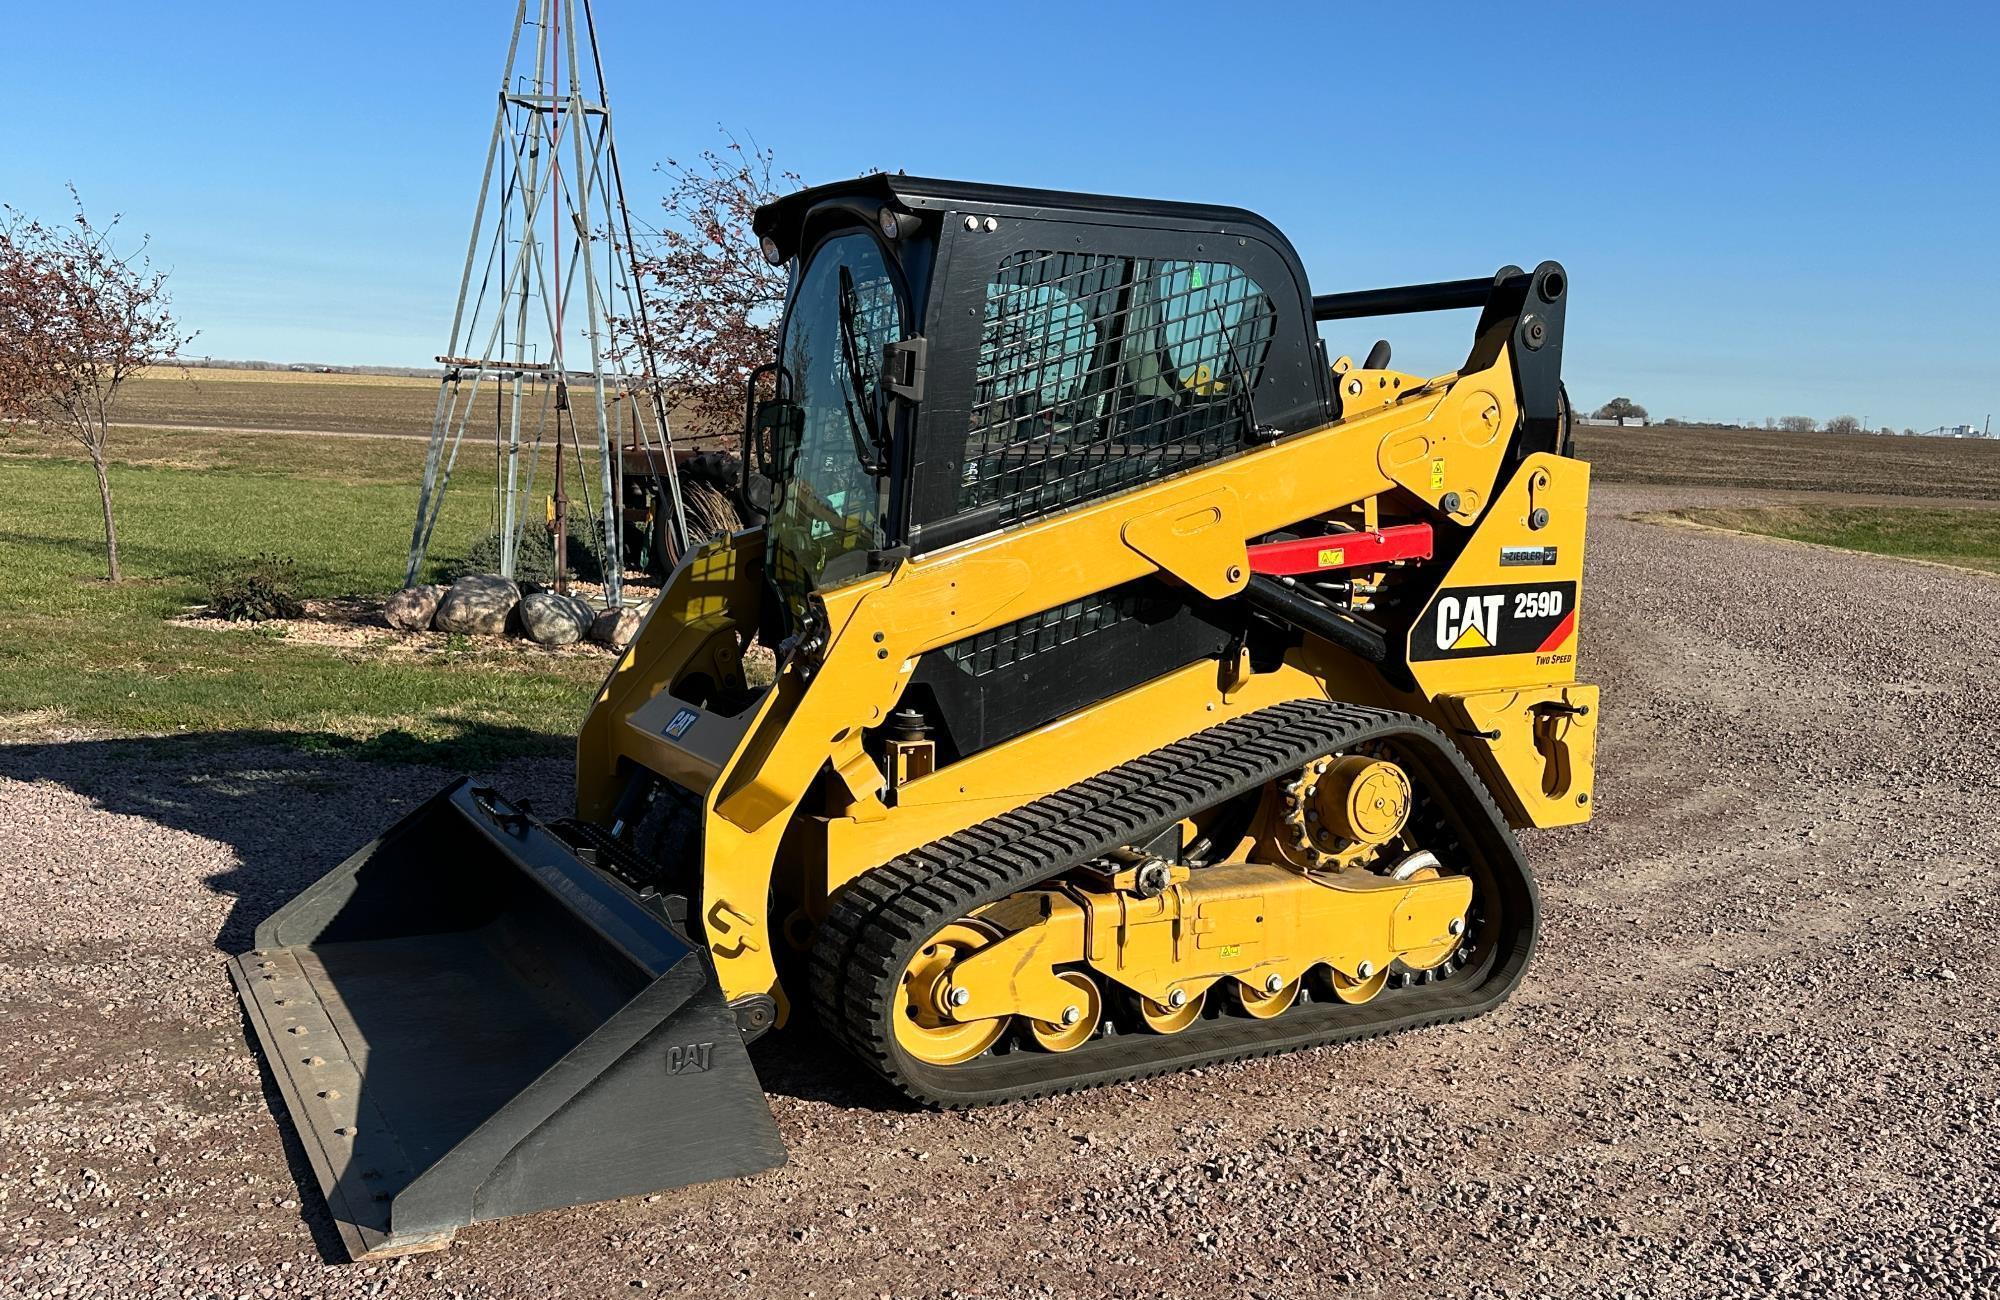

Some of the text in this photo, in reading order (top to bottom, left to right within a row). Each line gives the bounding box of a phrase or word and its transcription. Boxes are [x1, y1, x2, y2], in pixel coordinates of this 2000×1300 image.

[1508, 551, 1541, 561] ZIEGLER
[1436, 591, 1563, 650] CAT 259D
[666, 711, 696, 737] CAT
[666, 1042, 713, 1075] CAT
